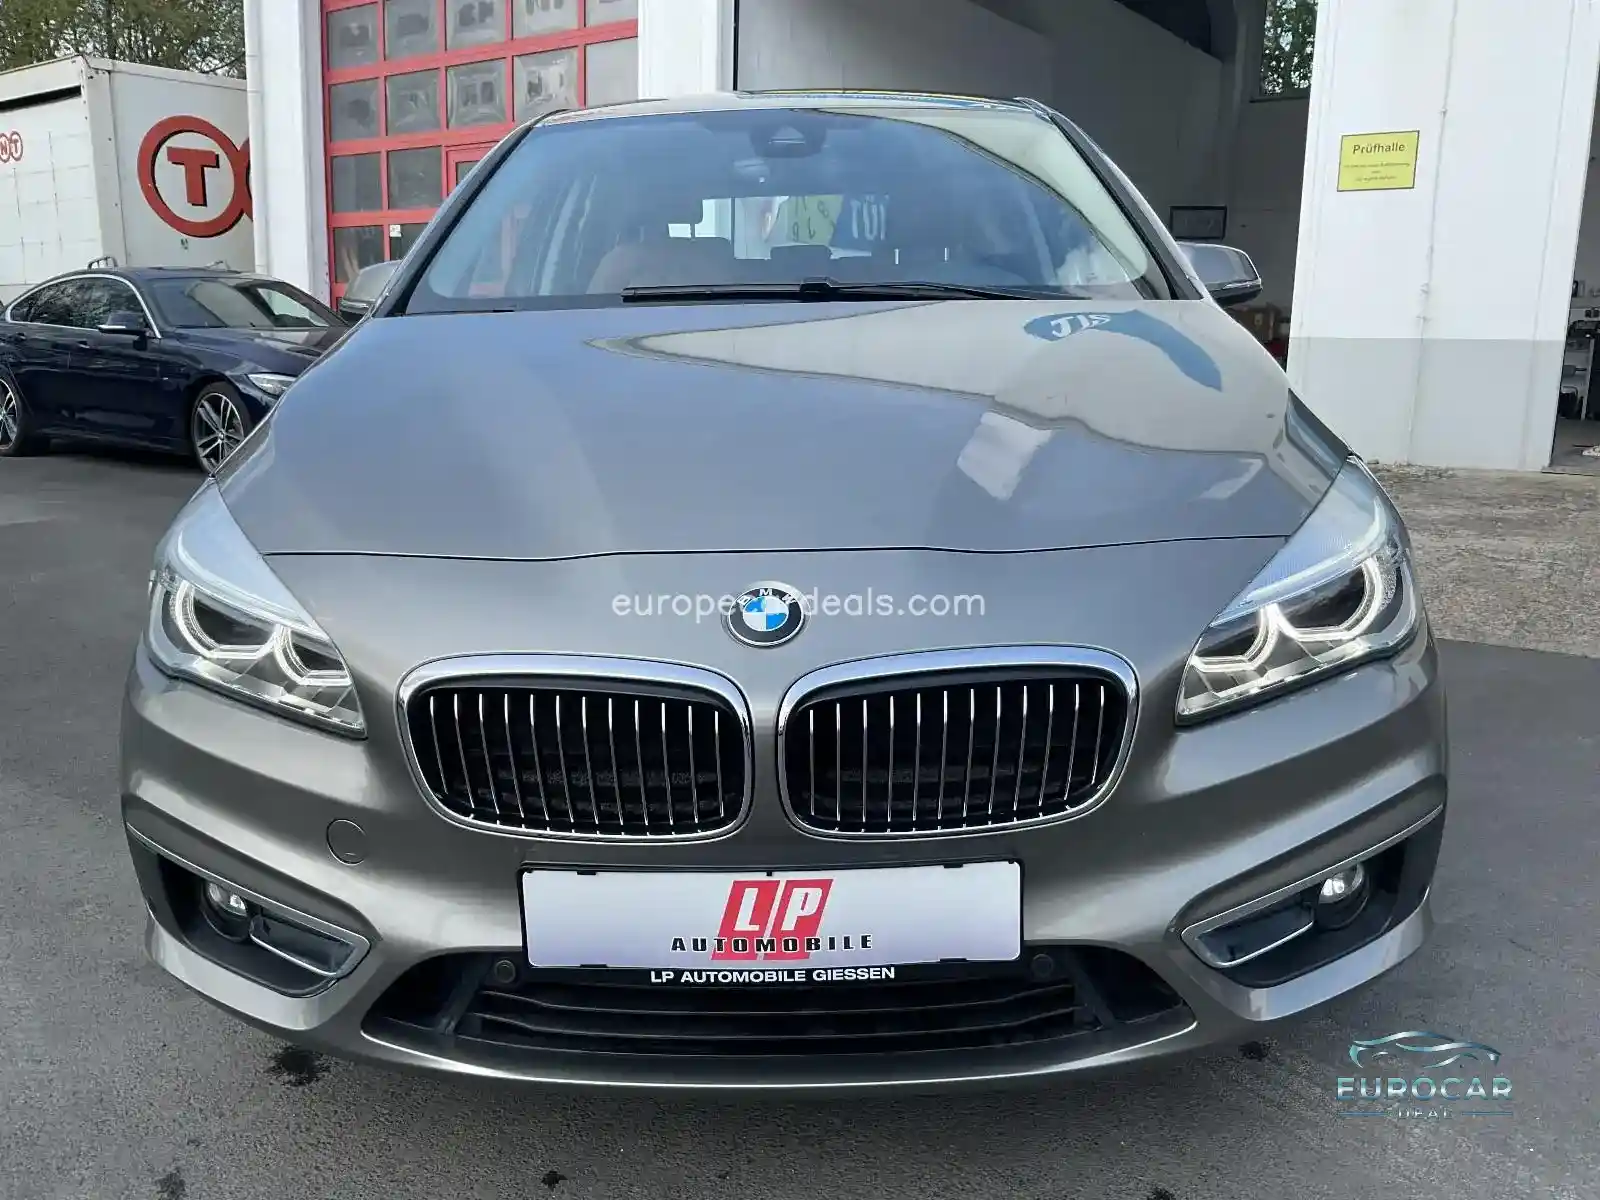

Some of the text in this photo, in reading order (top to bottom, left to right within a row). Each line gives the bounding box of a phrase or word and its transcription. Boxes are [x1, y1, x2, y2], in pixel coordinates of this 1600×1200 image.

[1352, 142, 1406, 155] Prüfhalle
[733, 887, 823, 932] LP
[670, 934, 873, 953] AUTOMOBILE
[650, 966, 896, 984] LP AUTOMOBILE GIESSEN
